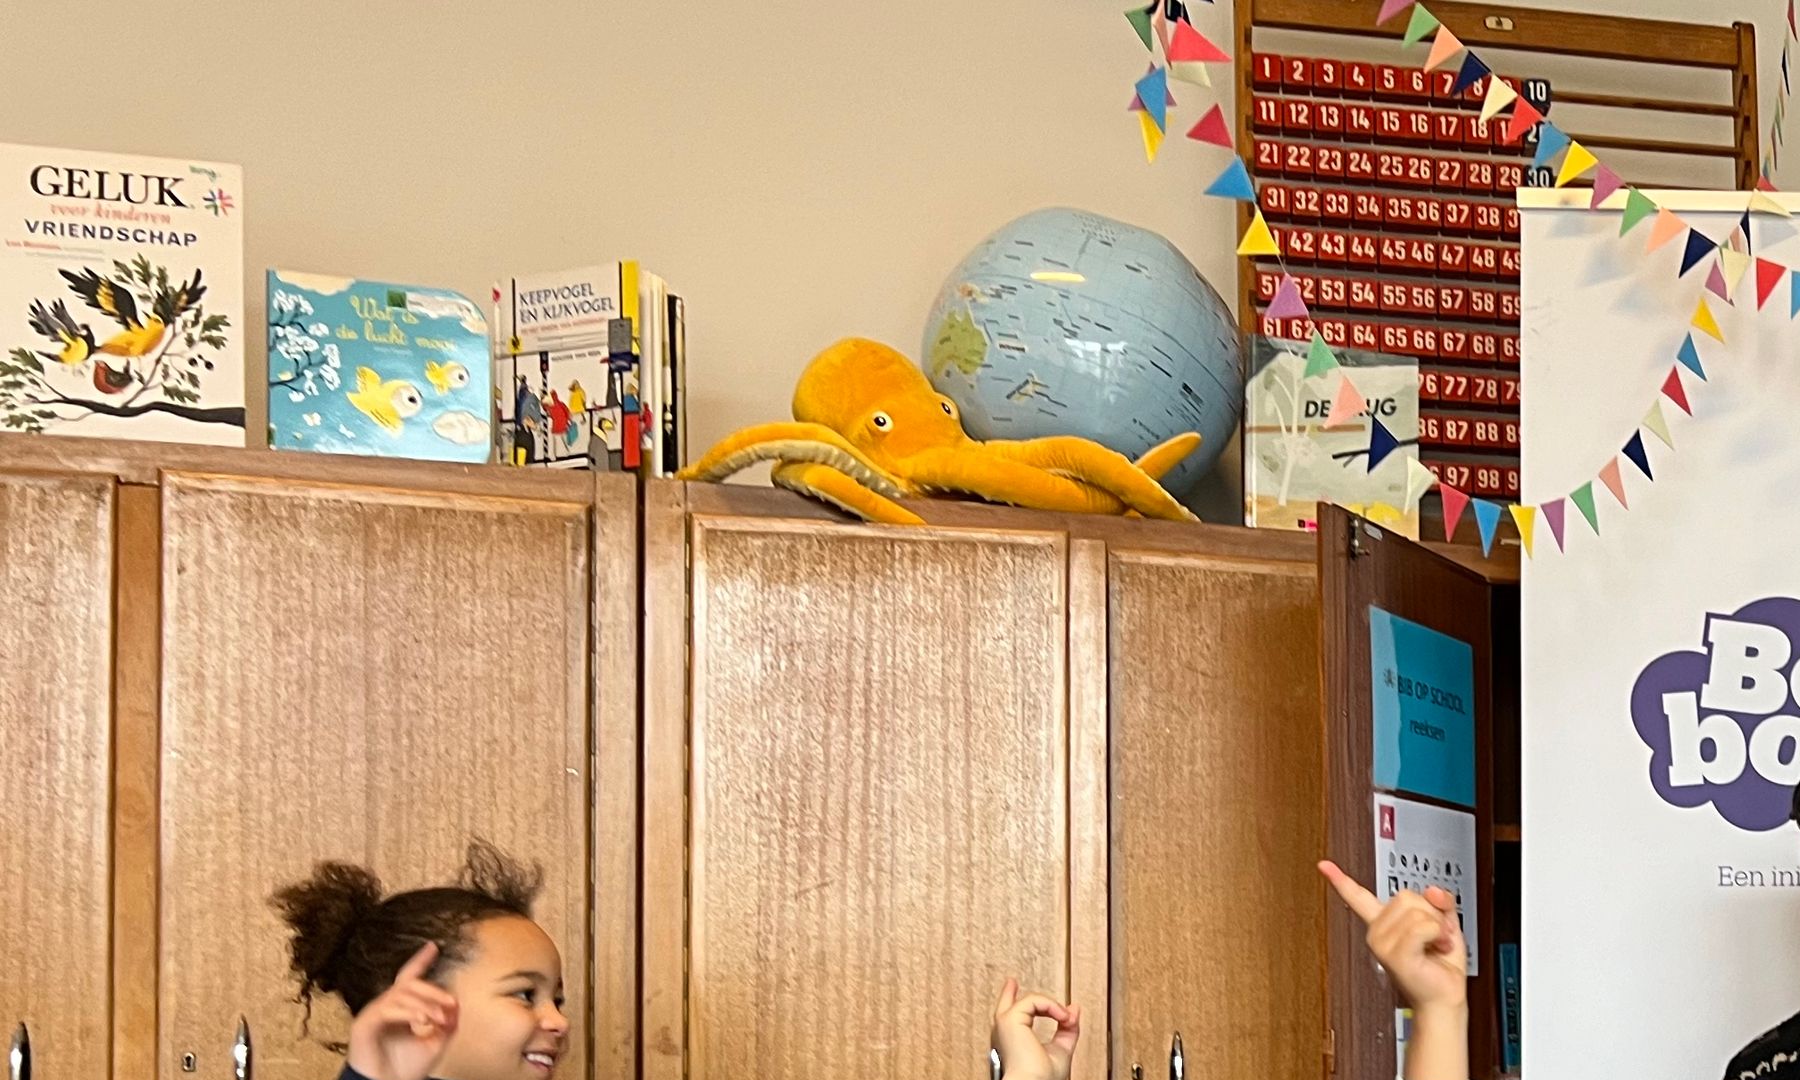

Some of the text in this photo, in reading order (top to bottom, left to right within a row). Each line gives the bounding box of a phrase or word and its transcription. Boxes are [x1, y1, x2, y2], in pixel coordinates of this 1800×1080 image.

[1264, 58, 1270, 77] 1
[1293, 61, 1303, 80] 2
[1324, 64, 1333, 83] 3
[1353, 66, 1364, 86] 4
[1384, 69, 1394, 88] 5
[1413, 72, 1423, 91] 6
[1443, 74, 1453, 93] 7
[1473, 78, 1483, 96] 8
[1528, 81, 1546, 102] 10
[1260, 101, 1275, 121] 11
[1290, 104, 1308, 124] 12
[1321, 106, 1338, 126] 13
[1352, 108, 1369, 129] 14
[1382, 111, 1399, 131] 15
[1411, 114, 1428, 133] 16
[1440, 116, 1457, 135] 17
[1471, 118, 1488, 138] 18
[1260, 143, 1550, 187] 21 22 23 24 25 26 27 28 29 30
[30, 165, 189, 209] GELUK
[1268, 188, 1518, 228] 31 32 33 34 35 36 37 38 3
[24, 218, 198, 246] VRIENDSCHAP
[1290, 231, 1313, 252] 42
[1321, 234, 1344, 254] 43
[1352, 237, 1375, 257] 44
[1383, 239, 1405, 259] 45
[1412, 242, 1434, 262] 46
[1442, 245, 1464, 264] 47
[1473, 248, 1494, 267] 48
[519, 283, 594, 306] KEEPVOGEL
[1262, 275, 1281, 295] 51
[1322, 280, 1344, 300] 53
[1352, 282, 1374, 303] 54
[1384, 285, 1405, 305] 55
[1413, 287, 1434, 308] 56
[1442, 289, 1463, 308] 57
[1472, 292, 1494, 312] 58
[520, 297, 614, 323] EN KIJKVOGEL
[1264, 319, 1281, 337] 61
[1291, 320, 1314, 338] 62
[1323, 323, 1345, 342] 63
[1354, 325, 1375, 345] 64
[1385, 328, 1407, 347] 65
[1414, 330, 1435, 350] 66
[1444, 332, 1465, 351] 67
[1473, 336, 1494, 354] 68
[1445, 376, 1466, 395] 77
[1476, 379, 1497, 398] 78
[1446, 420, 1468, 439] 87
[1476, 422, 1498, 441] 88
[1447, 467, 1469, 487] 97
[1478, 469, 1499, 488] 98
[1415, 681, 1429, 700] OP
[1382, 814, 1392, 833] A
[1718, 865, 1765, 887] Een
